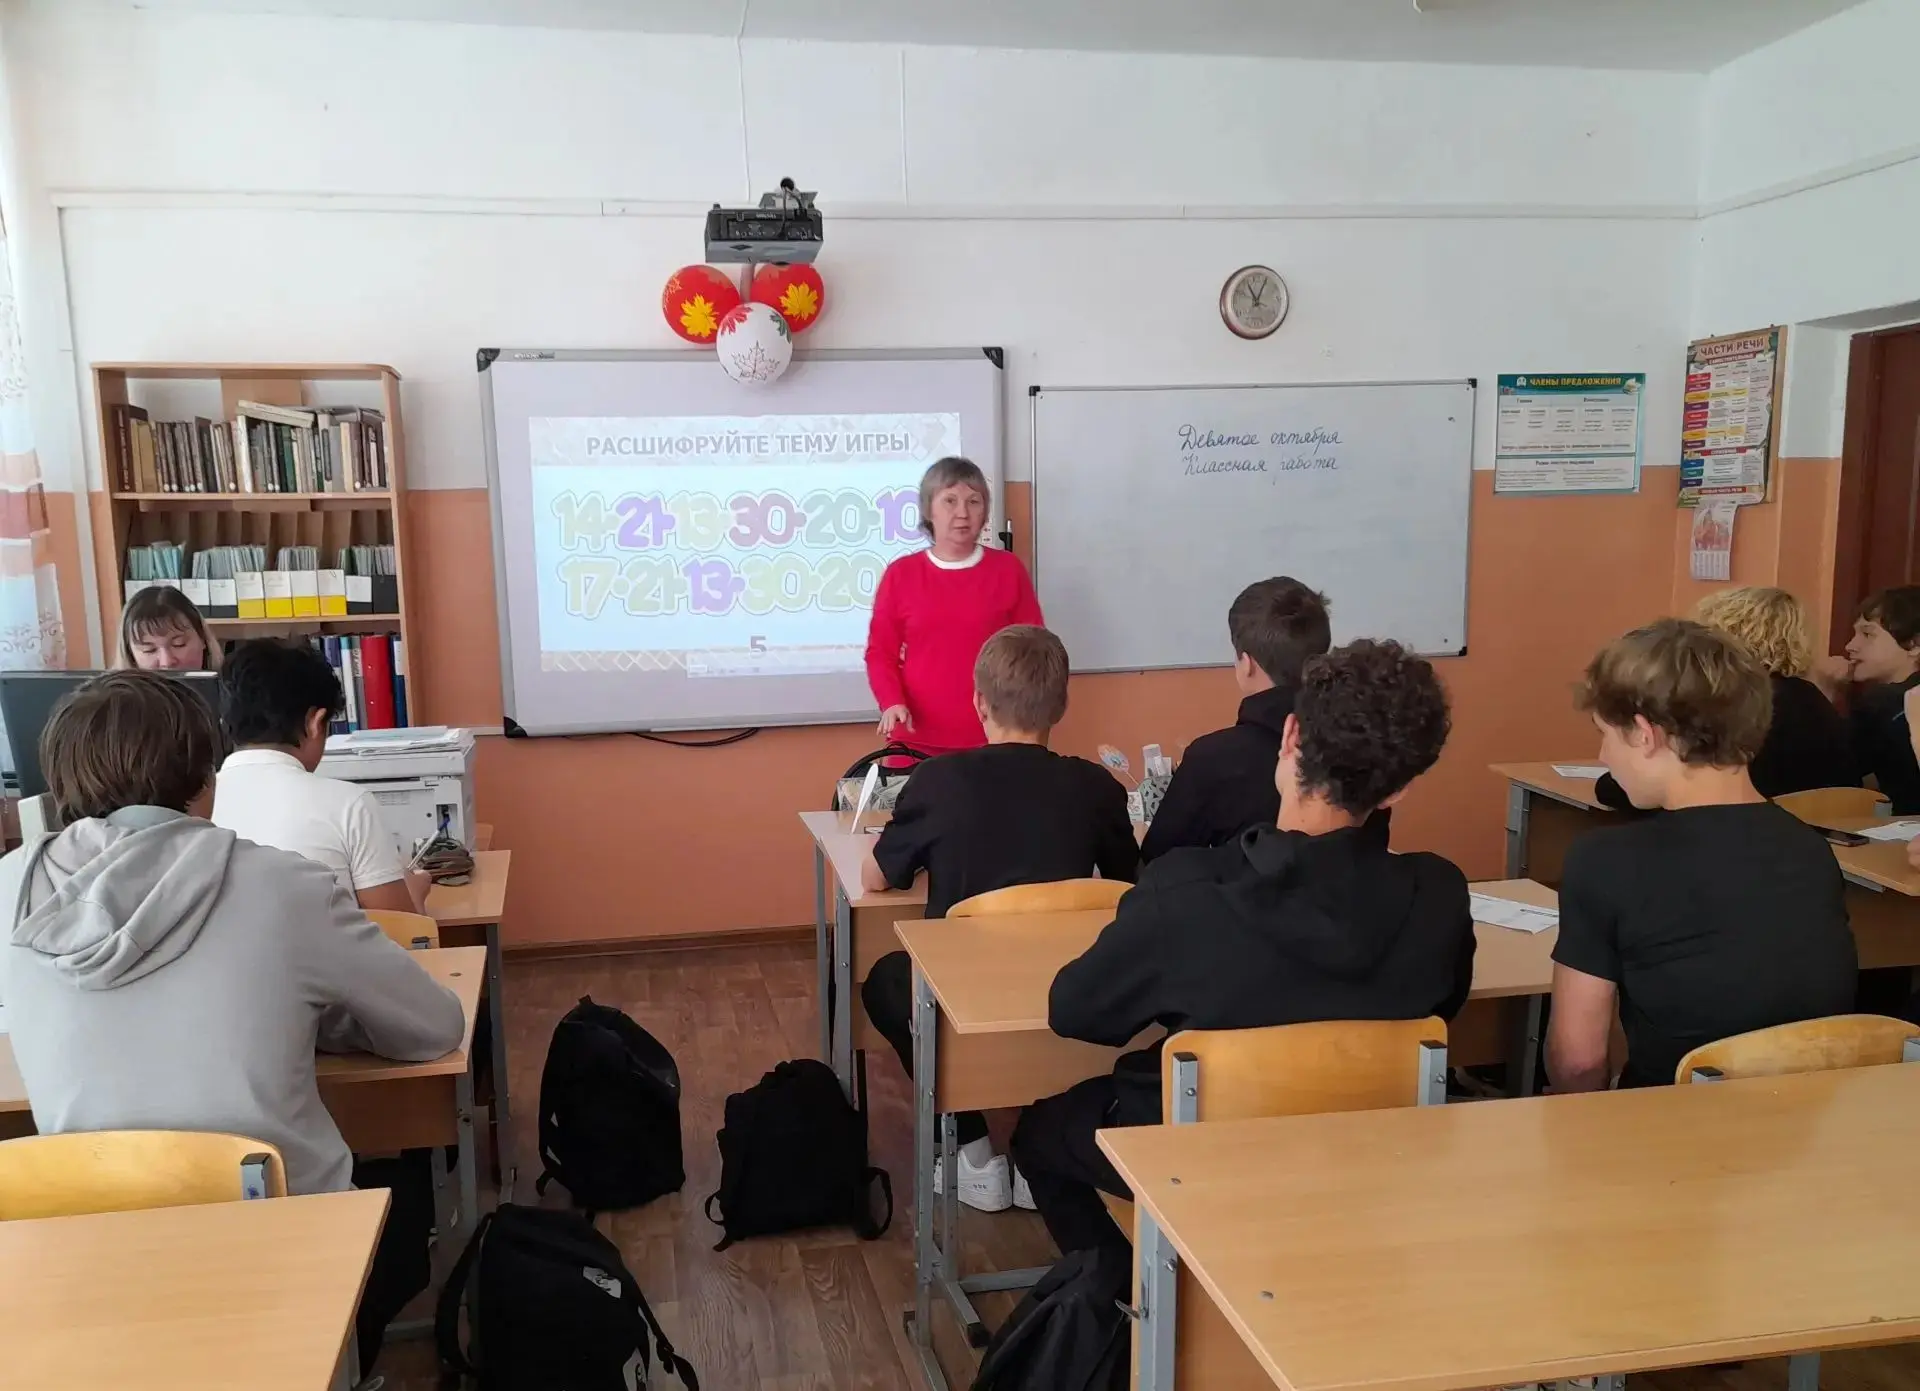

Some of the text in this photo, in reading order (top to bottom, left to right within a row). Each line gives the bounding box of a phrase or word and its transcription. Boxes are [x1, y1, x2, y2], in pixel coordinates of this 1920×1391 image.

[1700, 338, 1764, 357] ЧАСТИ РЕЧИ
[1529, 377, 1622, 386] ЧЛЕНЫ ПРЕДЛОЖЕНИЯ
[585, 431, 911, 457] РАСШИФРУЙТЕ ТЕМУ ИГРЫ
[1178, 424, 1343, 456] Девятое октября
[1182, 452, 1268, 476] Классная
[749, 635, 768, 655] 5
